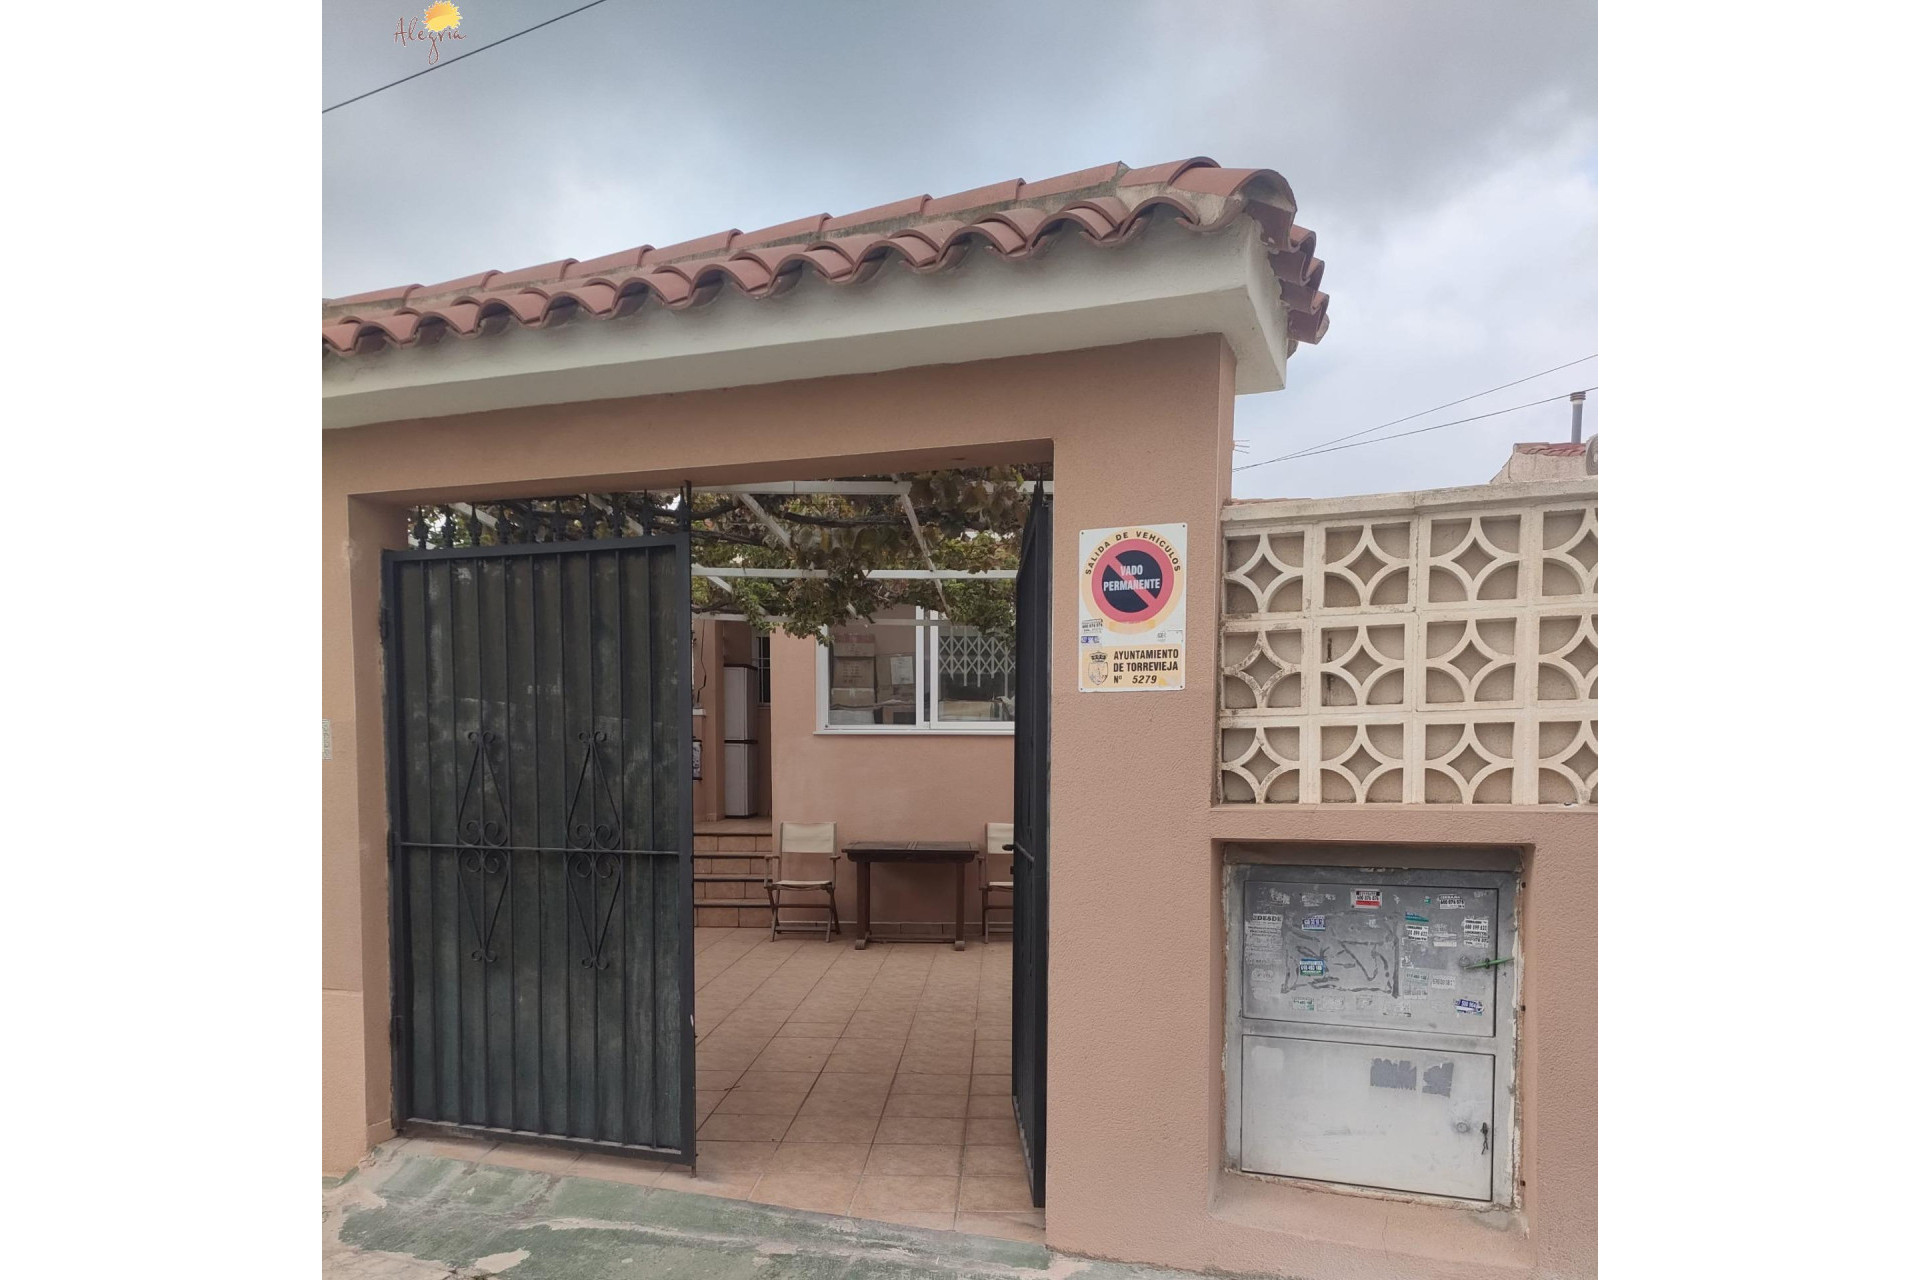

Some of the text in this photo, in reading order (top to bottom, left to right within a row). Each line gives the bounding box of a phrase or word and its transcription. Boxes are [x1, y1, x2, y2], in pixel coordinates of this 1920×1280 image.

[1085, 531, 1181, 575] SALIDA DE VEHICULOS
[1120, 564, 1143, 576] VADO
[1103, 578, 1161, 592] PERMANENTE
[1113, 648, 1179, 660] AYUNTAMIENTO
[1113, 661, 1179, 672] DE TORREVIEJA
[1132, 675, 1157, 684] 5279
